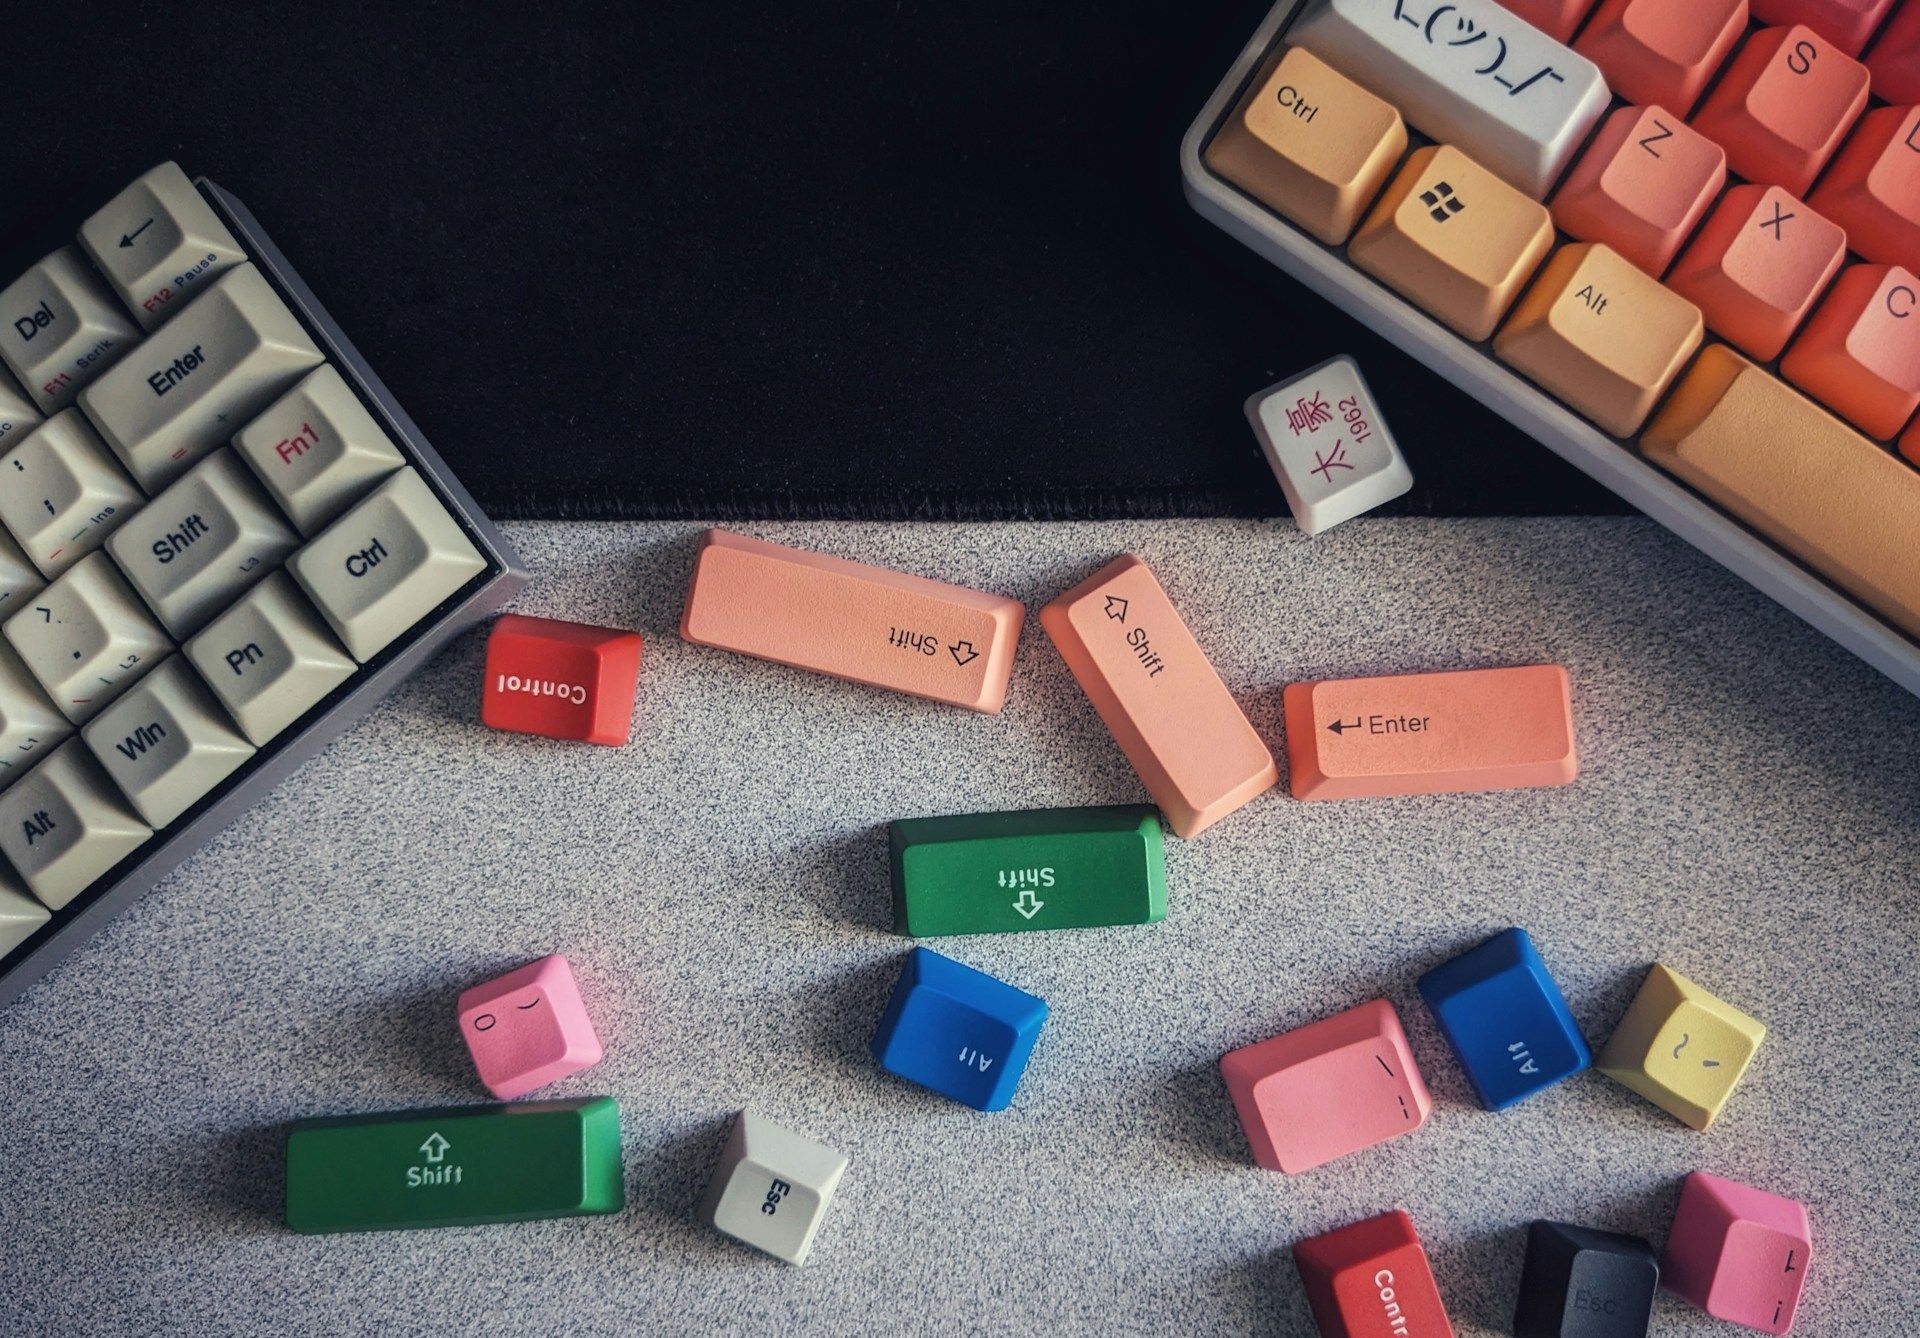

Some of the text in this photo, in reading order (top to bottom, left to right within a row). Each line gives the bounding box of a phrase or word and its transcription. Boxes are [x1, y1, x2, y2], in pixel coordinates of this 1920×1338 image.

[1787, 40, 1817, 75] S
[1277, 85, 1320, 124] Ctrl
[1638, 119, 1673, 158] Z
[1759, 201, 1795, 241] X
[143, 253, 218, 313] F12 Pause
[1575, 284, 1608, 316] Alt
[1886, 285, 1916, 318] C
[14, 301, 56, 342] Del
[43, 372, 72, 395] F11
[147, 345, 206, 397] Enter
[1338, 395, 1371, 444] 1962
[275, 422, 320, 465] Fn1
[90, 506, 115, 525] Ins
[152, 514, 209, 564] Shift
[239, 557, 260, 572] L3
[345, 537, 389, 578] Ctrl
[889, 627, 938, 656] Shift
[1126, 627, 1165, 679] Shift
[119, 654, 141, 670] L2
[225, 642, 264, 676] Pn
[498, 674, 587, 705] Control
[116, 721, 167, 761] Win
[1369, 715, 1430, 735] Enter
[18, 738, 38, 751] L1
[21, 809, 56, 845] Alt
[998, 867, 1056, 888] Shift
[959, 1046, 993, 1073] Alt
[1507, 1041, 1539, 1074] Alt
[406, 1165, 463, 1188] Shift
[761, 1178, 791, 1216] Esc
[1575, 1290, 1616, 1315] Esc
